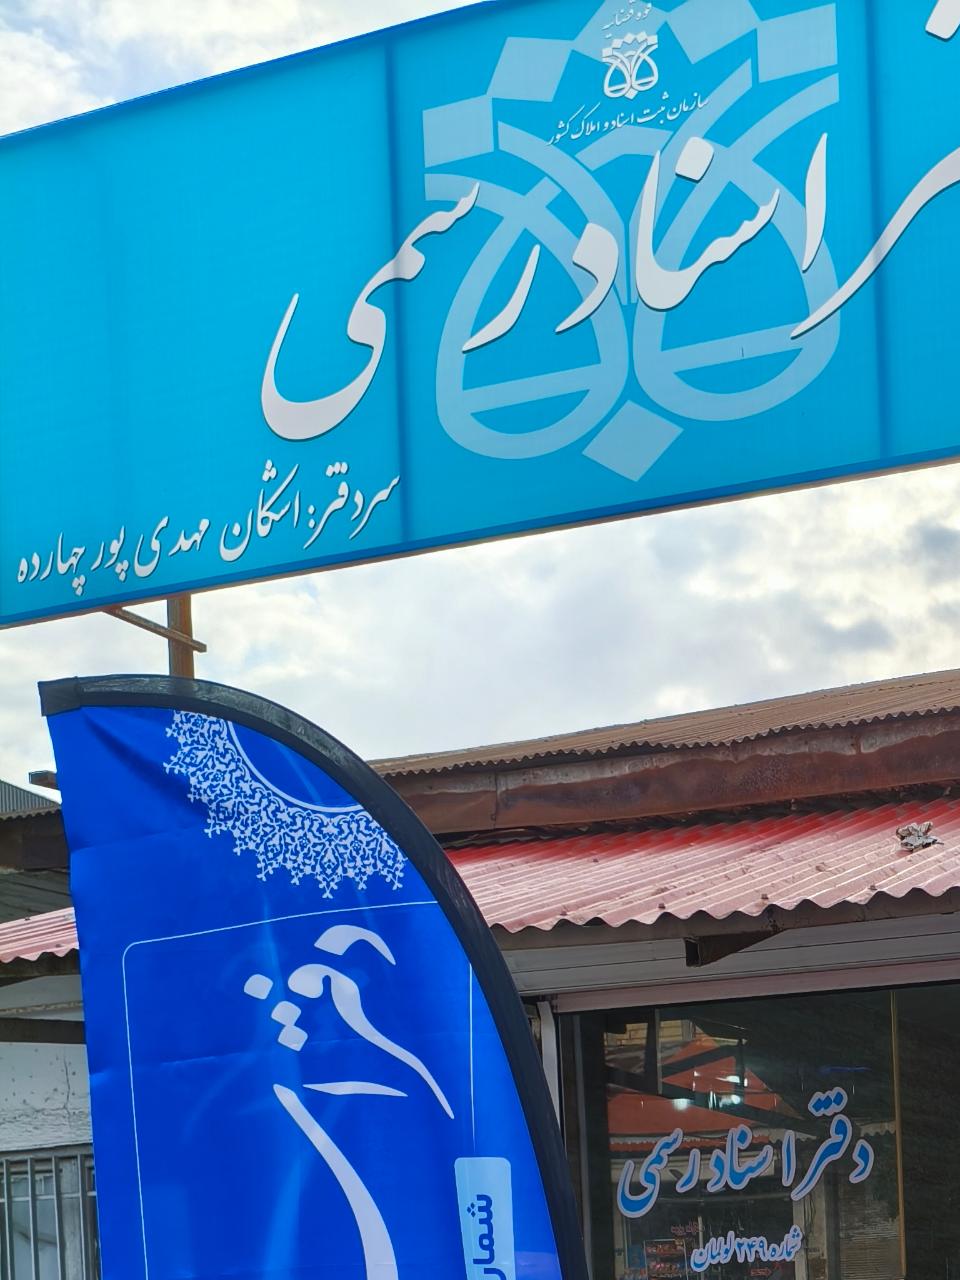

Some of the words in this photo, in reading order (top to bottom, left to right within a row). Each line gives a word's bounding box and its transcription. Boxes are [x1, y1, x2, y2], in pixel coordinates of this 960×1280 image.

[547, 104, 586, 146] کشور
[570, 102, 601, 140] املاک
[603, 121, 610, 131] و
[611, 112, 634, 130] اسناد
[637, 91, 669, 124] ثبت
[667, 92, 710, 120] سازمان
[556, 134, 828, 333] اسناد
[261, 183, 480, 441] رسمی
[219, 459, 299, 562] اشکان
[17, 532, 86, 596] چهارده
[91, 527, 129, 582] پور
[134, 516, 210, 578] مهدی
[243, 924, 455, 1119] دفتر
[707, 1126, 796, 1193] اسناد
[790, 1087, 874, 1200] دفتر
[617, 1128, 700, 1219] رسمی
[734, 1236, 769, 1263] ۲۴۹
[769, 1224, 803, 1261] شماره
